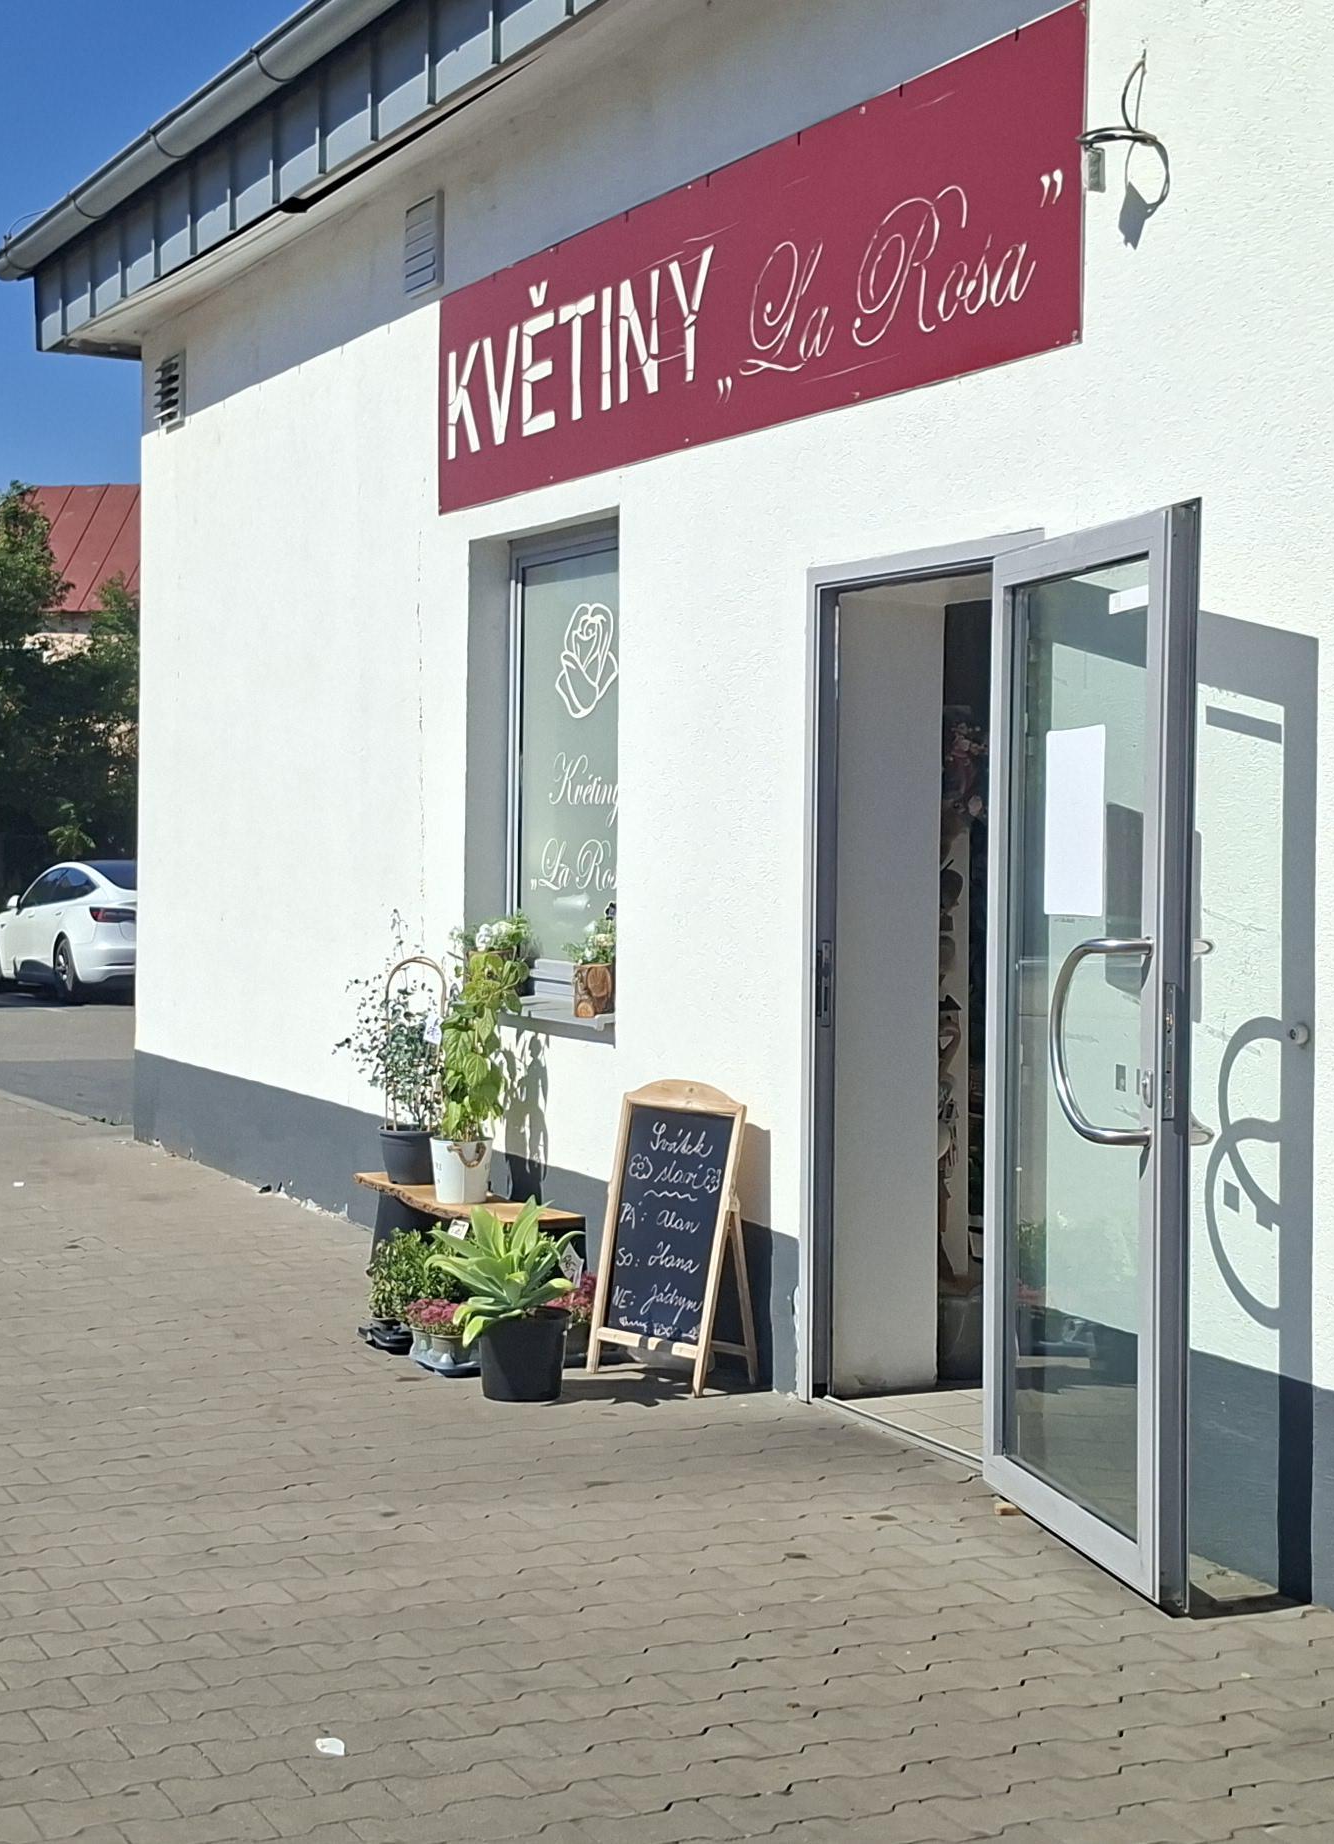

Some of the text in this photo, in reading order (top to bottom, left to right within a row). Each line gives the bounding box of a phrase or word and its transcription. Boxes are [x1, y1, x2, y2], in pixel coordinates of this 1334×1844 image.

[447, 246, 715, 460] KVĚTINY
[650, 1121, 713, 1158] Svátek
[654, 1160, 706, 1190] slaví
